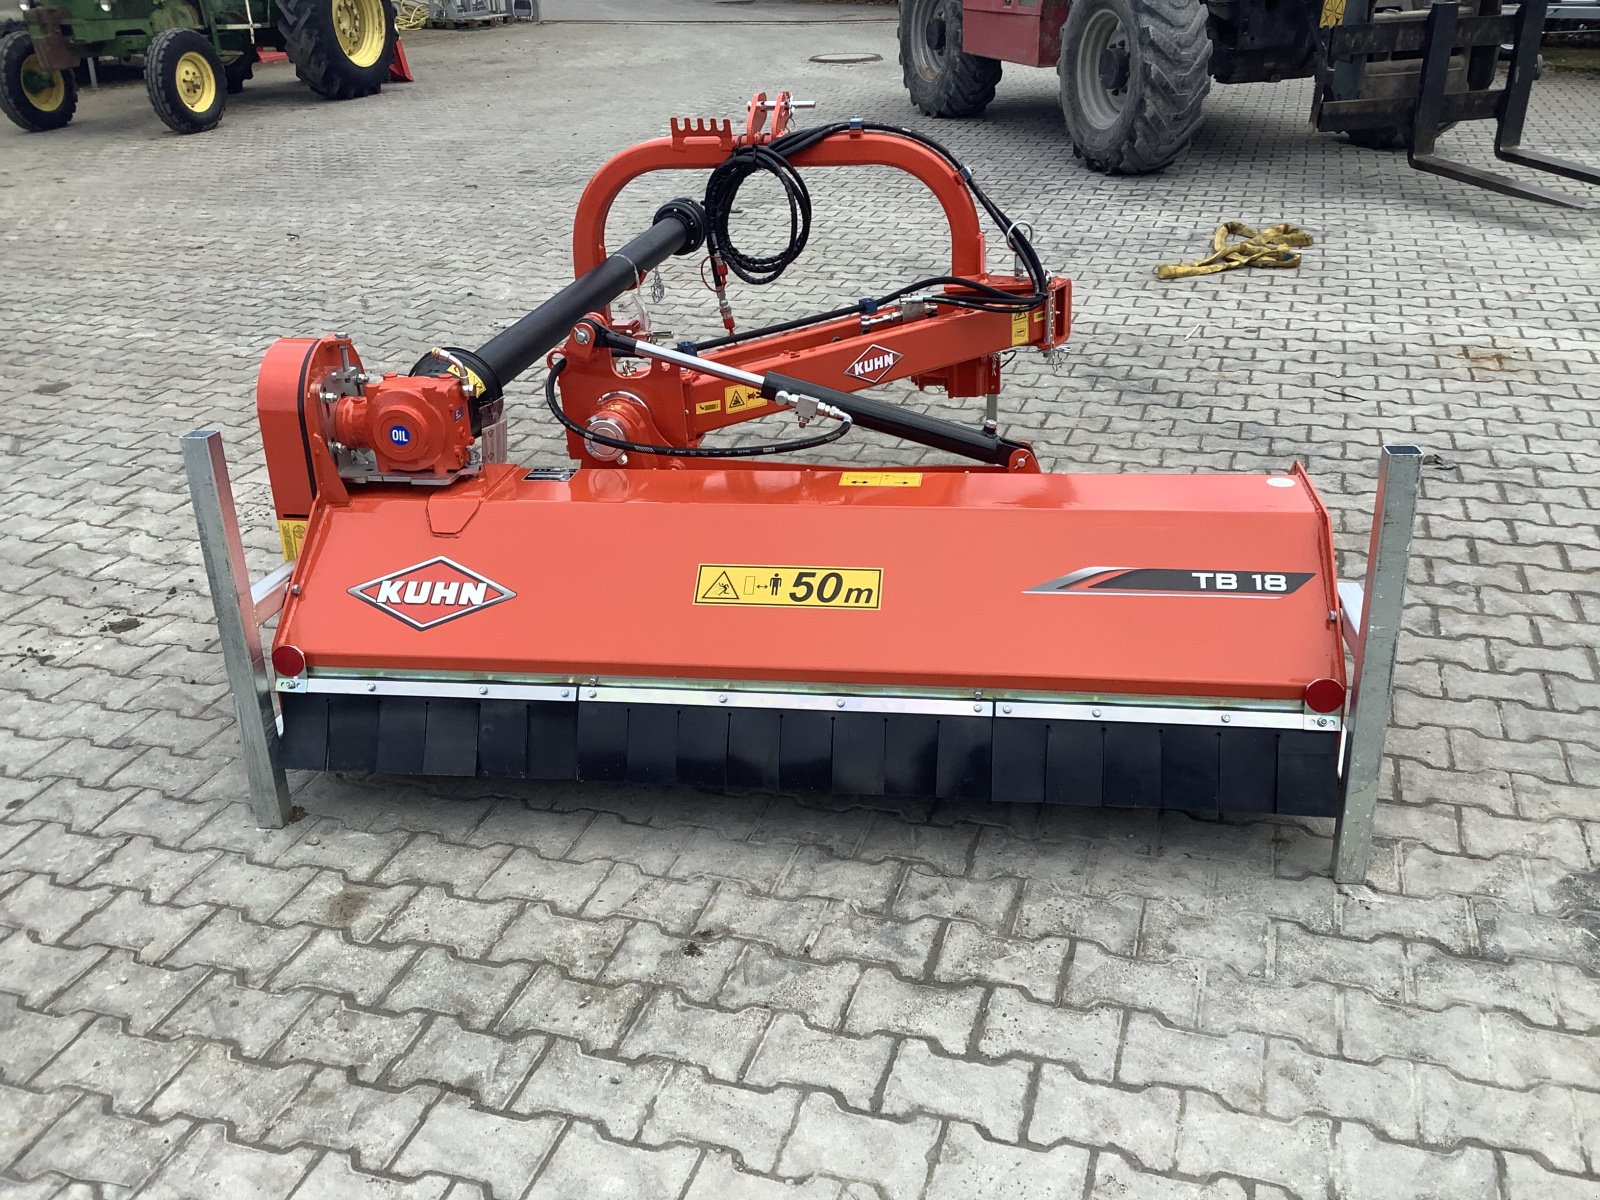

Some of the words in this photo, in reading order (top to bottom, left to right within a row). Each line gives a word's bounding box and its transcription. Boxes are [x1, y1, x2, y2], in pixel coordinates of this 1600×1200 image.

[854, 352, 894, 376] KUHN
[391, 429, 408, 442] OIL
[1191, 572, 1238, 590] TB
[1251, 574, 1287, 591] 18
[376, 580, 488, 606] KUHN
